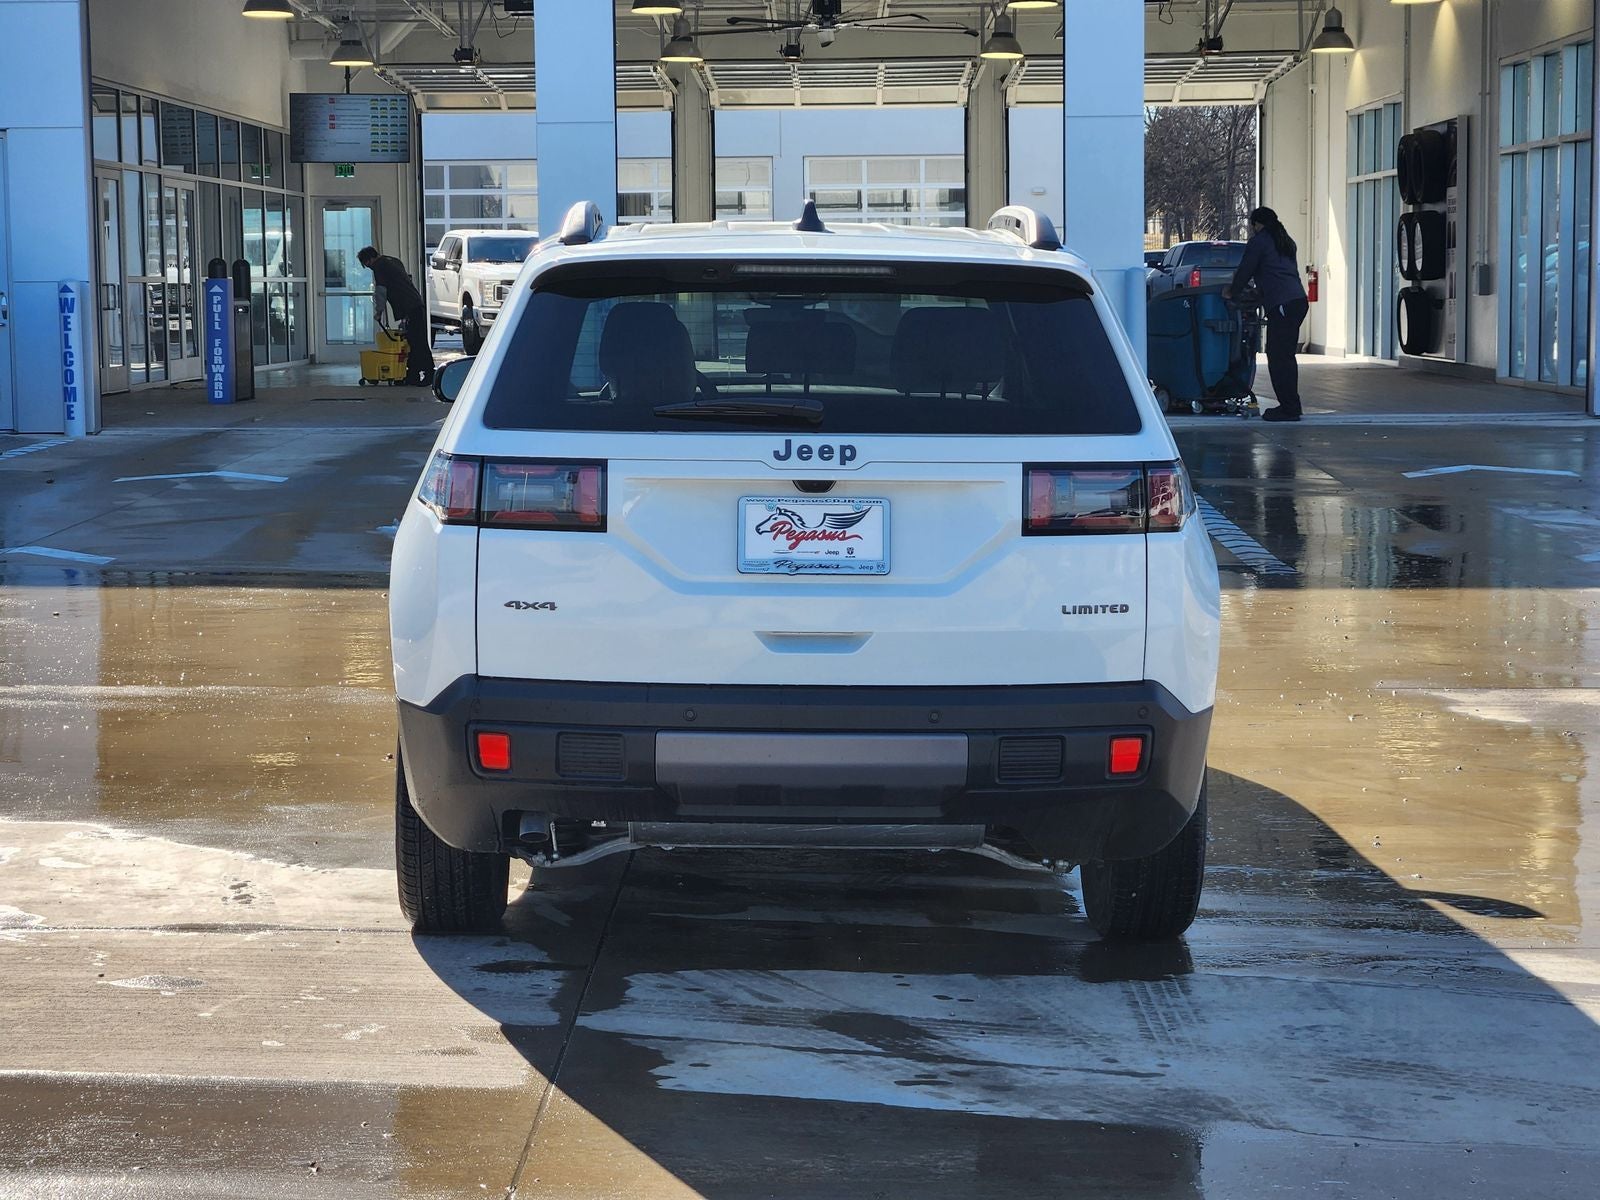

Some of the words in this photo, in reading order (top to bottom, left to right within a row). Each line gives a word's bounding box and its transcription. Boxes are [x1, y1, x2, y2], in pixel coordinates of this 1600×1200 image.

[213, 295, 222, 330] PULL
[59, 297, 77, 421] WELCOME
[211, 338, 225, 399] FORWARD
[773, 439, 857, 466] Jeep
[770, 521, 863, 550] Pegasus
[1062, 604, 1129, 614] LIMITED
